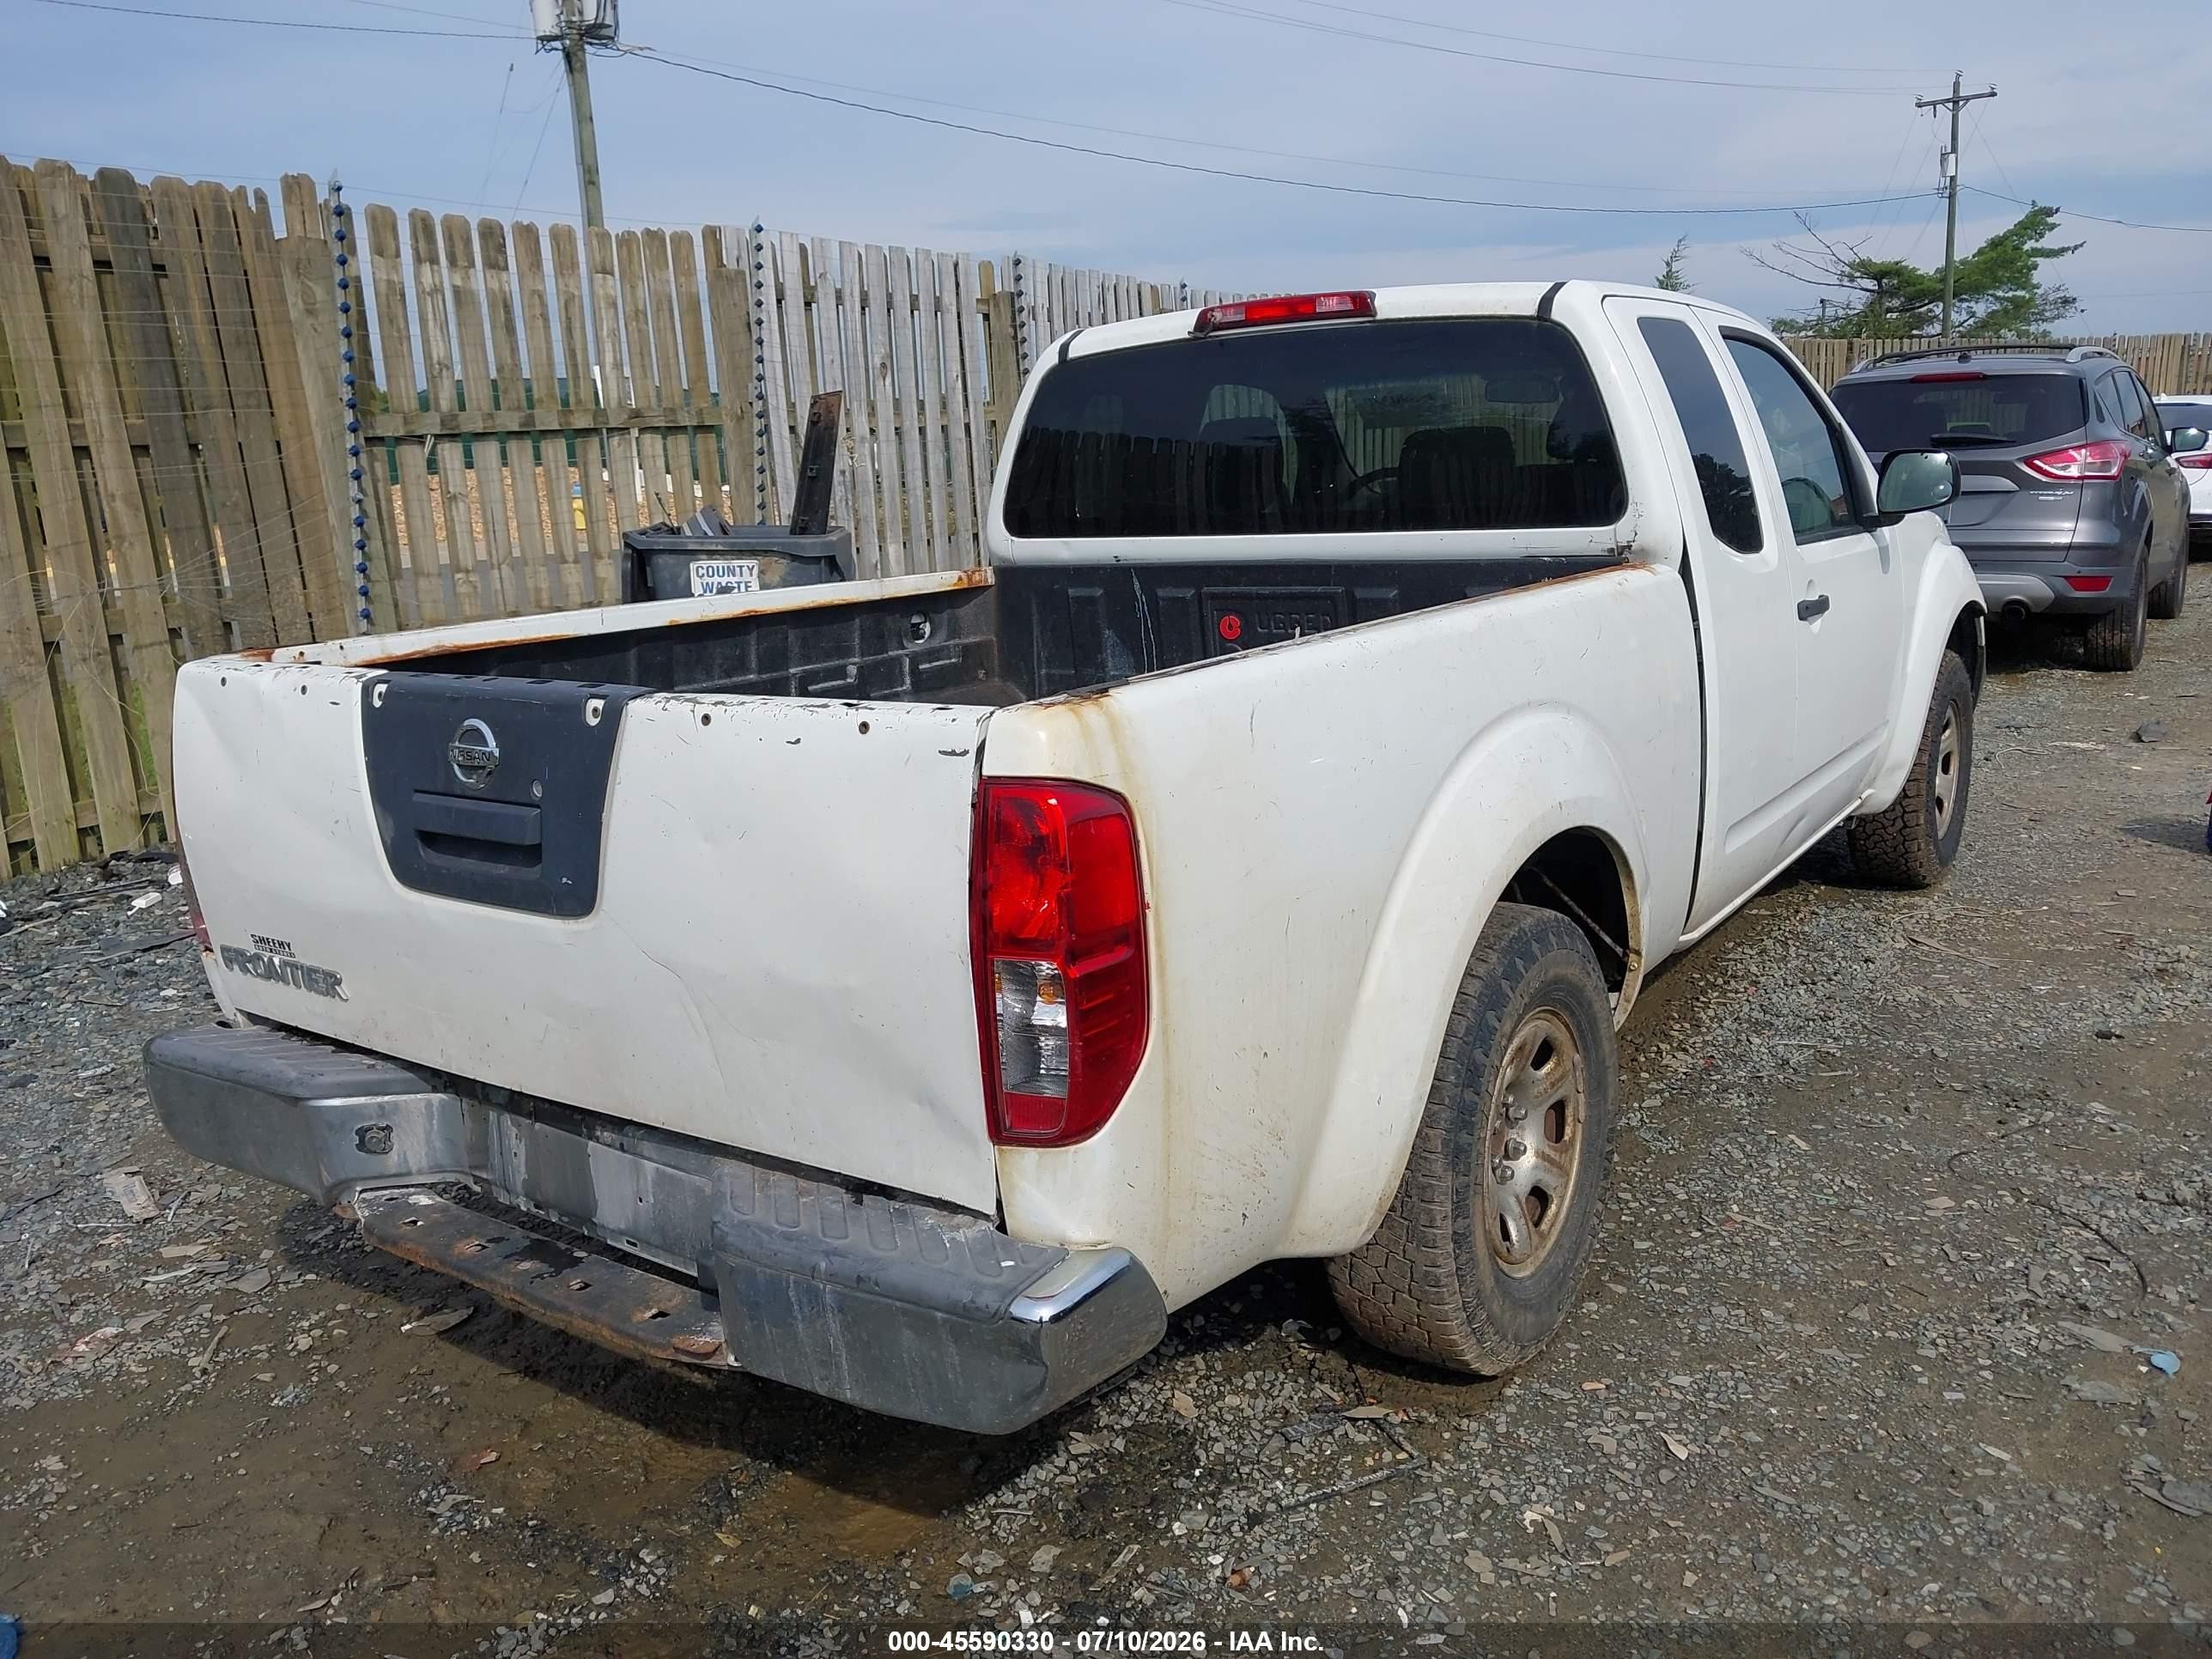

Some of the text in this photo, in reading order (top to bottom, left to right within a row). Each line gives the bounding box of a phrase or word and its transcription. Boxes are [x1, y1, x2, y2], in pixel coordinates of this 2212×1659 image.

[696, 565, 756, 578] COUNTY
[449, 748, 490, 763] NISSAN
[250, 933, 292, 951] SHEEHY
[220, 944, 349, 1002] FRONTIER
